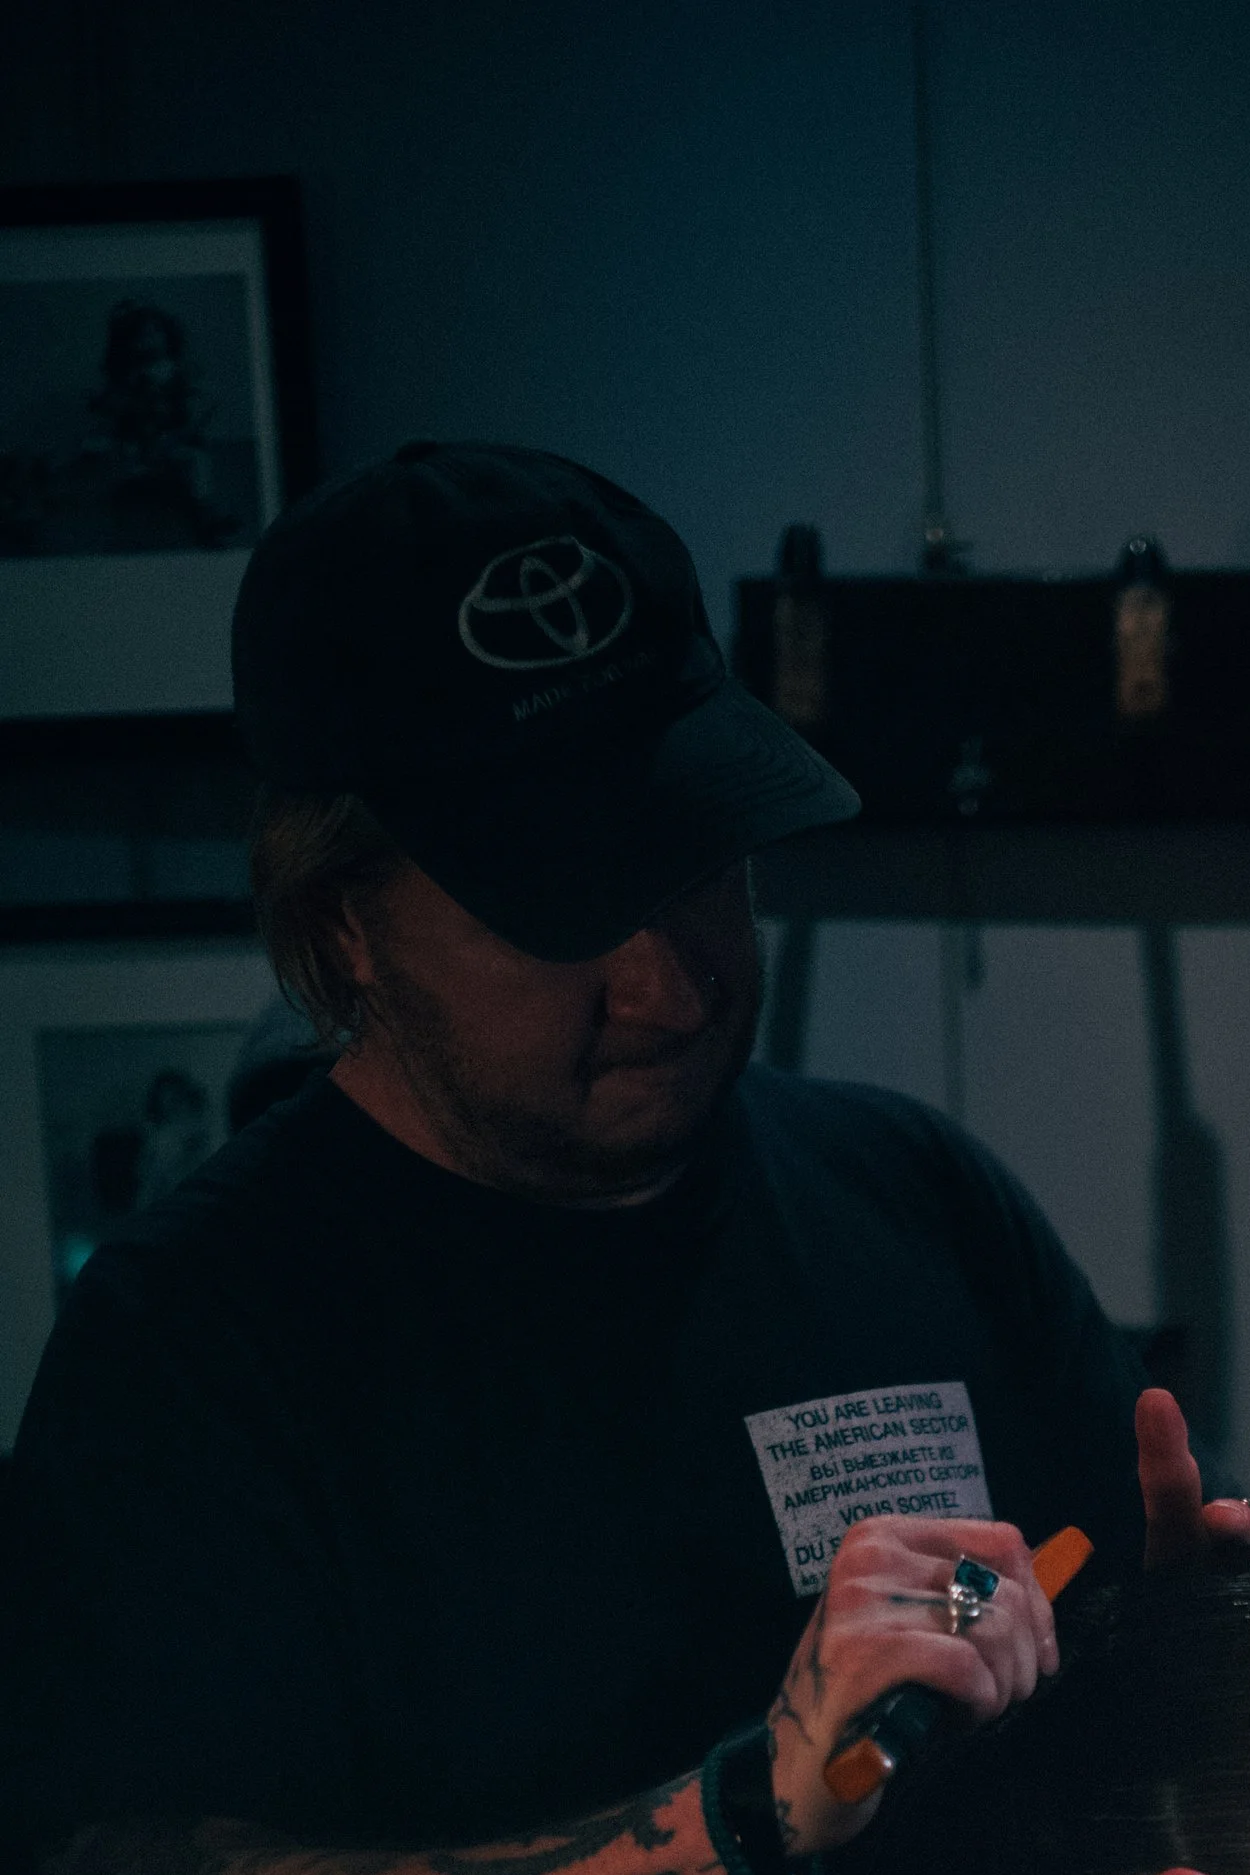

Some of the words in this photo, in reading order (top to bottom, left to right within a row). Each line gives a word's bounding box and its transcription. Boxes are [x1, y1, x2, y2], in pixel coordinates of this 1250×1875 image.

[788, 1408, 830, 1430] YOU
[834, 1401, 869, 1420] ARE
[873, 1392, 942, 1414] LEAVING
[766, 1439, 810, 1462] THE
[815, 1421, 908, 1452] AMERICAN
[910, 1415, 969, 1435] SECTOR
[811, 1461, 839, 1481] ВЫ
[784, 1468, 925, 1511] АМЕРИКАНСКОГО
[839, 1500, 894, 1525] VOUS
[897, 1491, 961, 1514] SORTEZ
[795, 1542, 825, 1566] DU
